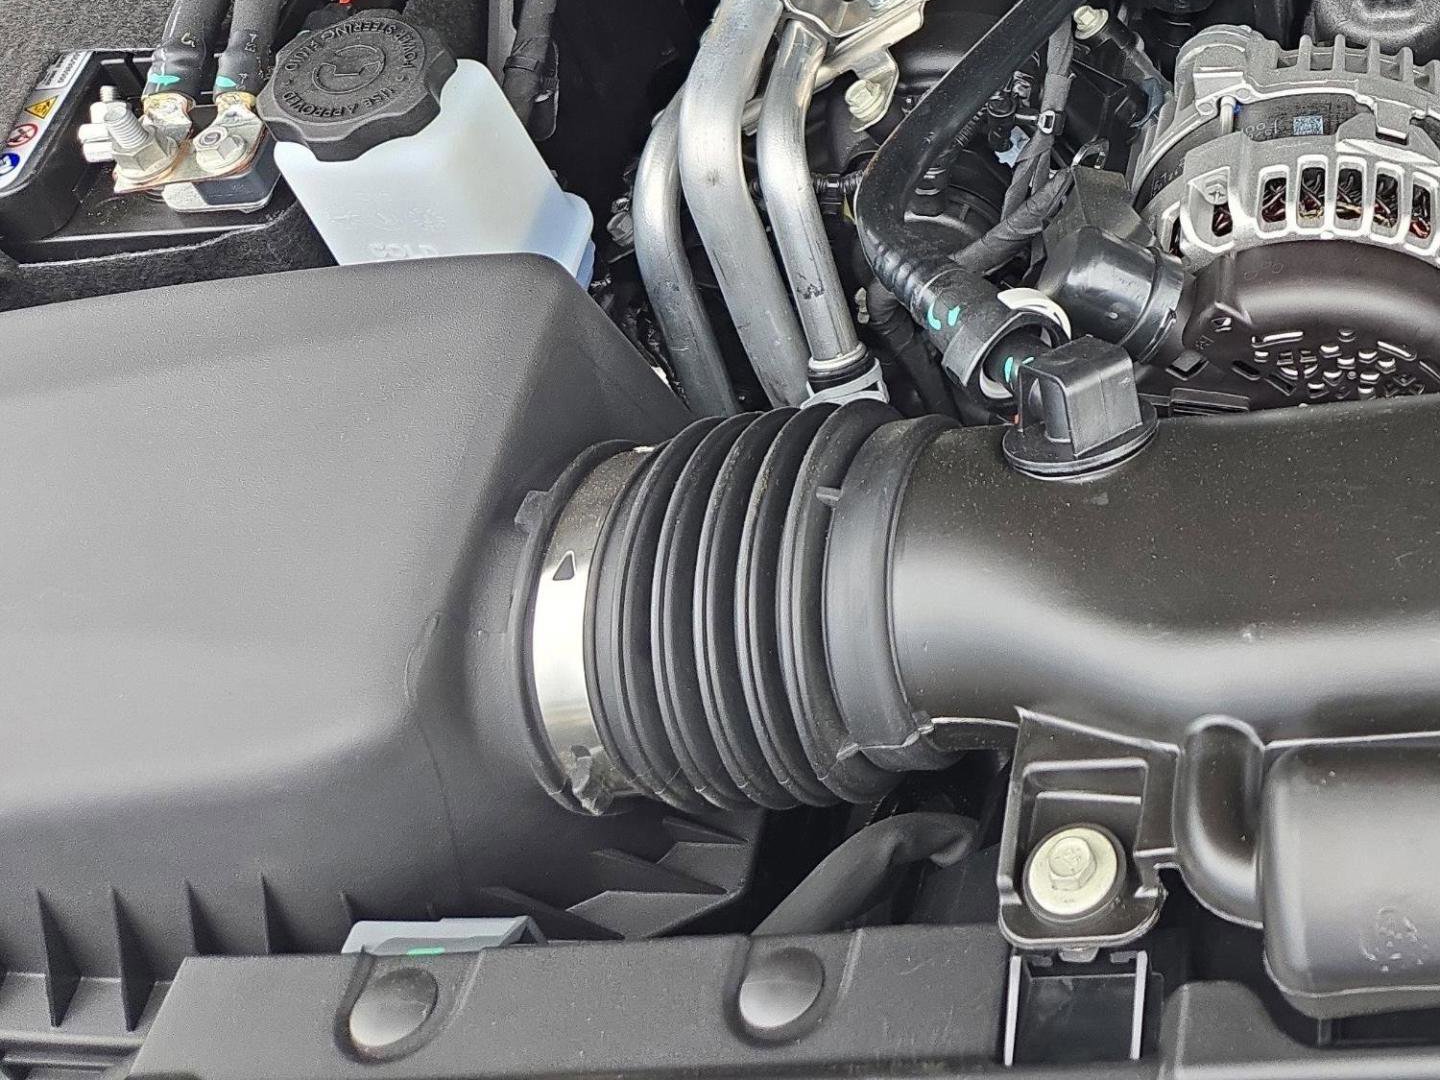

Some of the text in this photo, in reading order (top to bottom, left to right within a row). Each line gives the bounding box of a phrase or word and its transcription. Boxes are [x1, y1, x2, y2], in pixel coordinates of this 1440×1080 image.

[321, 20, 397, 41] STEERING
[394, 30, 418, 70] POWER
[283, 87, 396, 119] USE APPROVED
